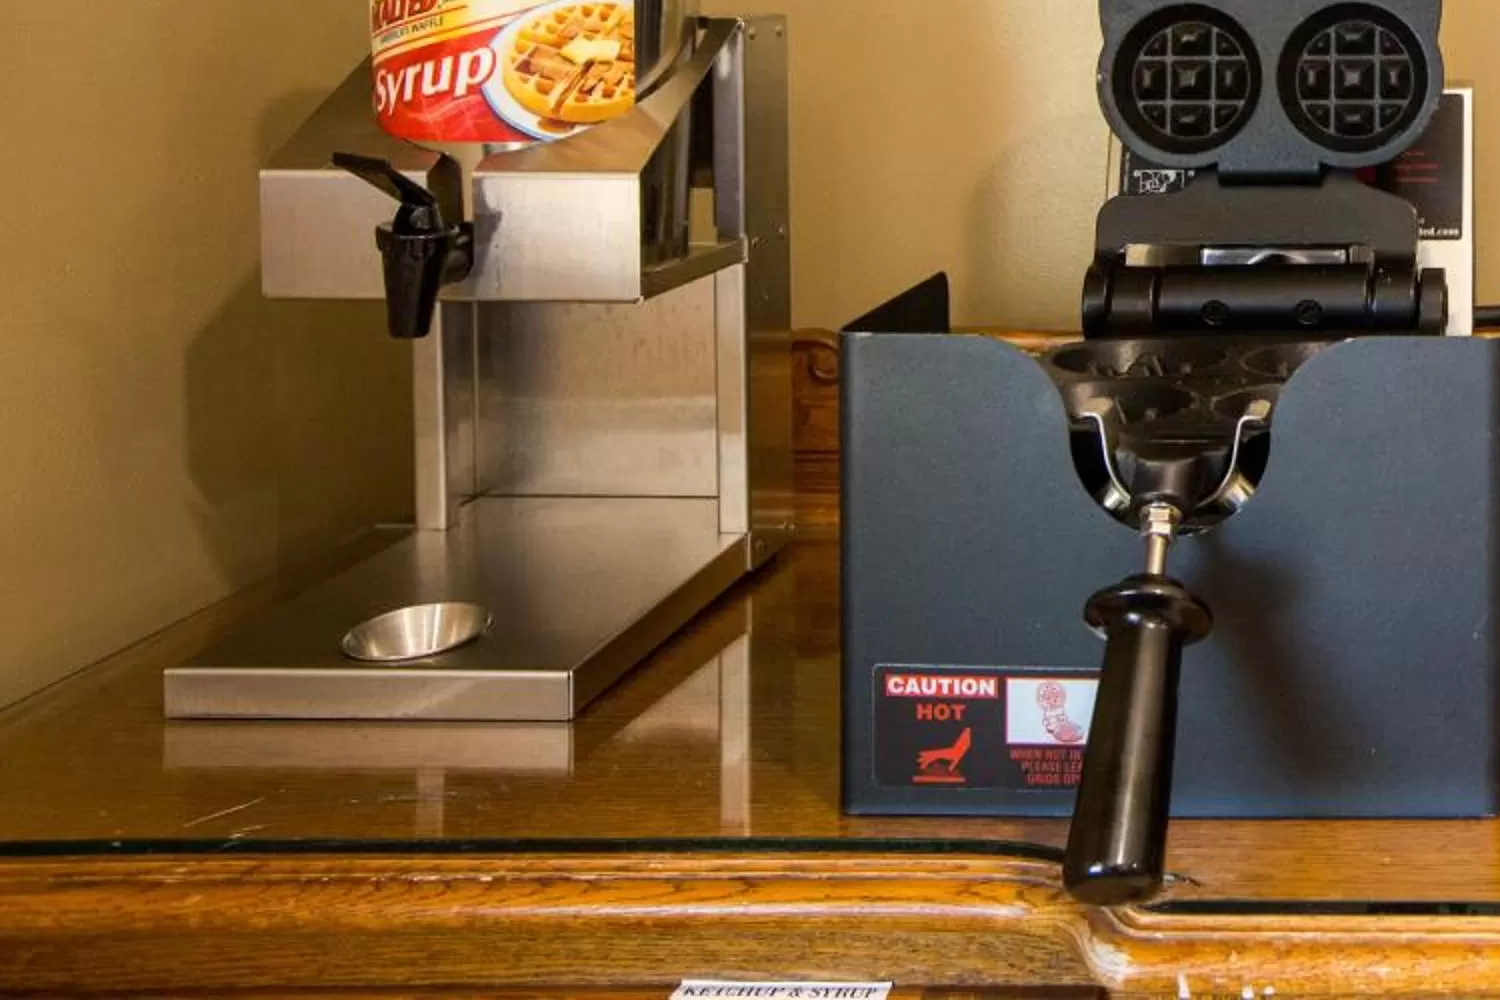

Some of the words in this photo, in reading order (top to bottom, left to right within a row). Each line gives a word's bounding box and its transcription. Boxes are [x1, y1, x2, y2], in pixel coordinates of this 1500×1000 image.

[376, 47, 495, 116] Syrup
[887, 678, 996, 696] CAUTION
[917, 704, 966, 720] HOT
[682, 985, 785, 998] KETCHUP
[787, 986, 801, 997] &
[807, 987, 878, 999] SYRUP
